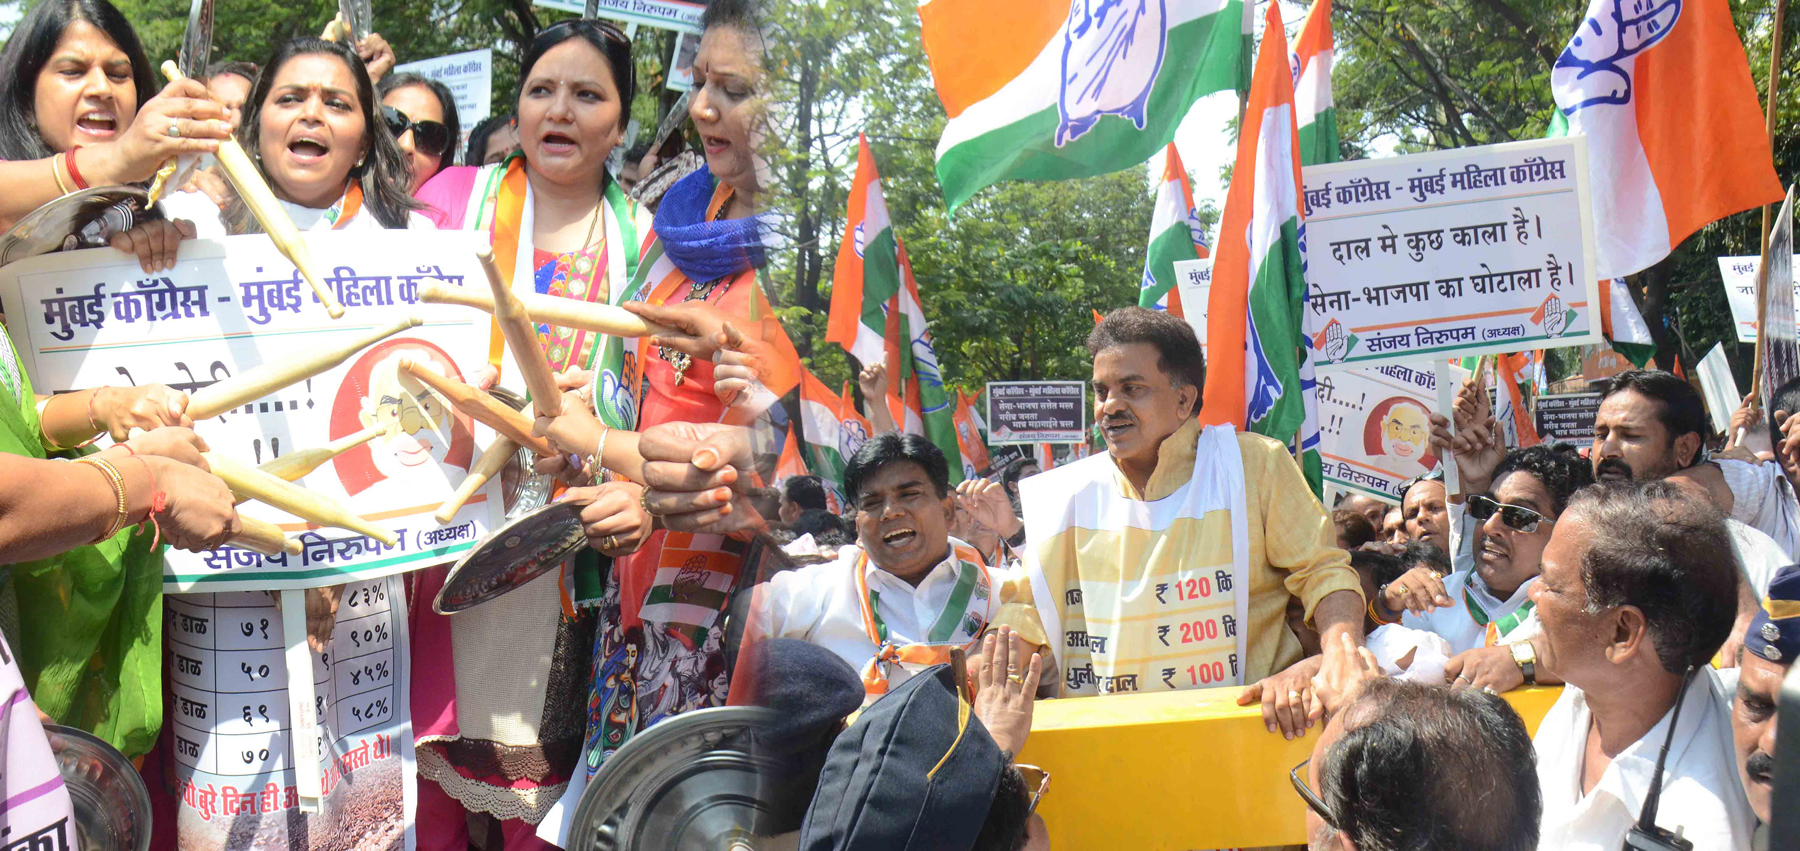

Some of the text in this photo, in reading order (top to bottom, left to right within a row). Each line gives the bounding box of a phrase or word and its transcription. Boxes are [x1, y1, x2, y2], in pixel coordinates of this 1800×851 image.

[1408, 168, 1446, 202] मुंबई
[1450, 164, 1506, 190] महिला
[1330, 237, 1371, 265] दाल
[1404, 229, 1444, 262] कुछ
[1450, 221, 1507, 247] काला
[1188, 266, 1211, 285] मुंबई
[1435, 277, 1463, 298] का
[1470, 263, 1541, 294] घोटाला
[1732, 263, 1754, 276] मुंबई
[40, 283, 106, 341] मुंबई
[239, 266, 303, 325] मुंबई
[1366, 332, 1411, 352] संजय
[1414, 326, 1476, 347] निरुपम
[1337, 462, 1390, 491] निरुपम
[1175, 577, 1211, 601] 120
[180, 615, 208, 636] डाळ
[1180, 619, 1217, 644] 200
[176, 654, 203, 677] डाळ
[1187, 662, 1224, 686] 100
[180, 695, 208, 720] डाळ
[176, 735, 200, 759] डाळ
[198, 783, 217, 821] बुरे
[221, 785, 257, 816] दिन
[260, 782, 279, 813] ही
